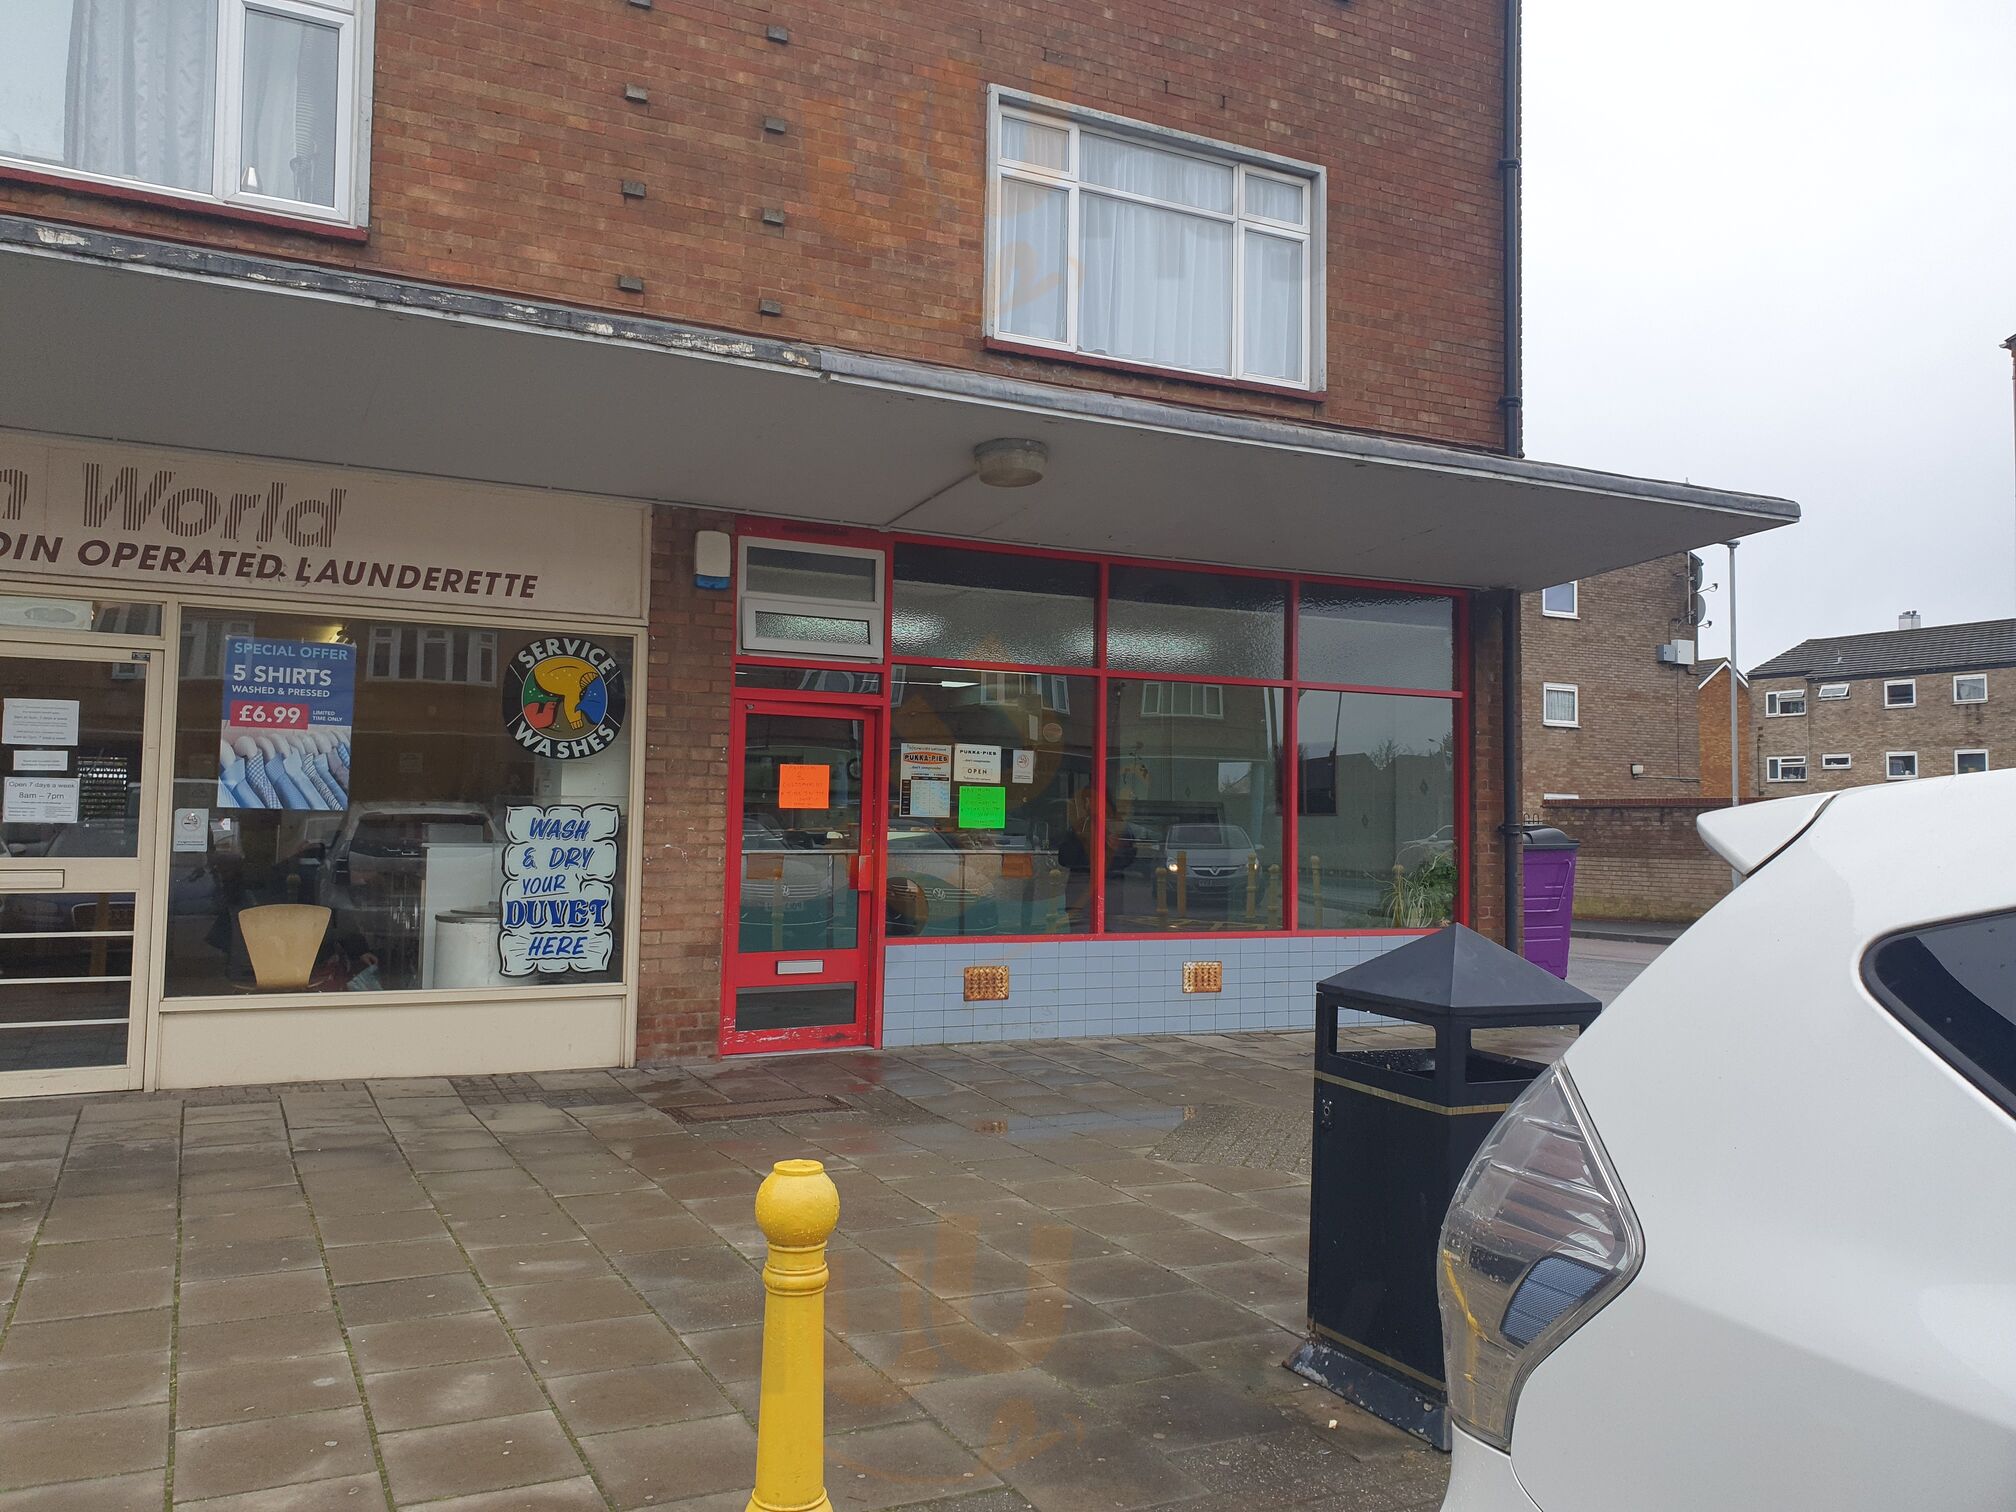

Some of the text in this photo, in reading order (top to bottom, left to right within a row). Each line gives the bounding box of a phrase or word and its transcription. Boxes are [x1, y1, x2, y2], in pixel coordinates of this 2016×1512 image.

[83, 462, 347, 548] World
[77, 539, 283, 579] OPERATED
[295, 557, 539, 599] LAUNDERETTE
[234, 642, 348, 660] SPECIAL OFFER
[518, 638, 616, 675] SERVICE
[233, 664, 332, 686] 5 SHIRTS
[232, 685, 330, 697] WASHED & PRESSED
[239, 704, 301, 724] £6.99
[515, 720, 615, 759] WASHES
[967, 767, 988, 775] OPEN
[8, 781, 28, 789] Open
[19, 791, 37, 799] 8am
[47, 792, 65, 800] 7pm
[529, 817, 591, 841] WASH
[522, 847, 595, 870] & DRY
[522, 874, 566, 895] YOUR
[504, 899, 610, 929] DUVET
[528, 936, 588, 956] HERE
